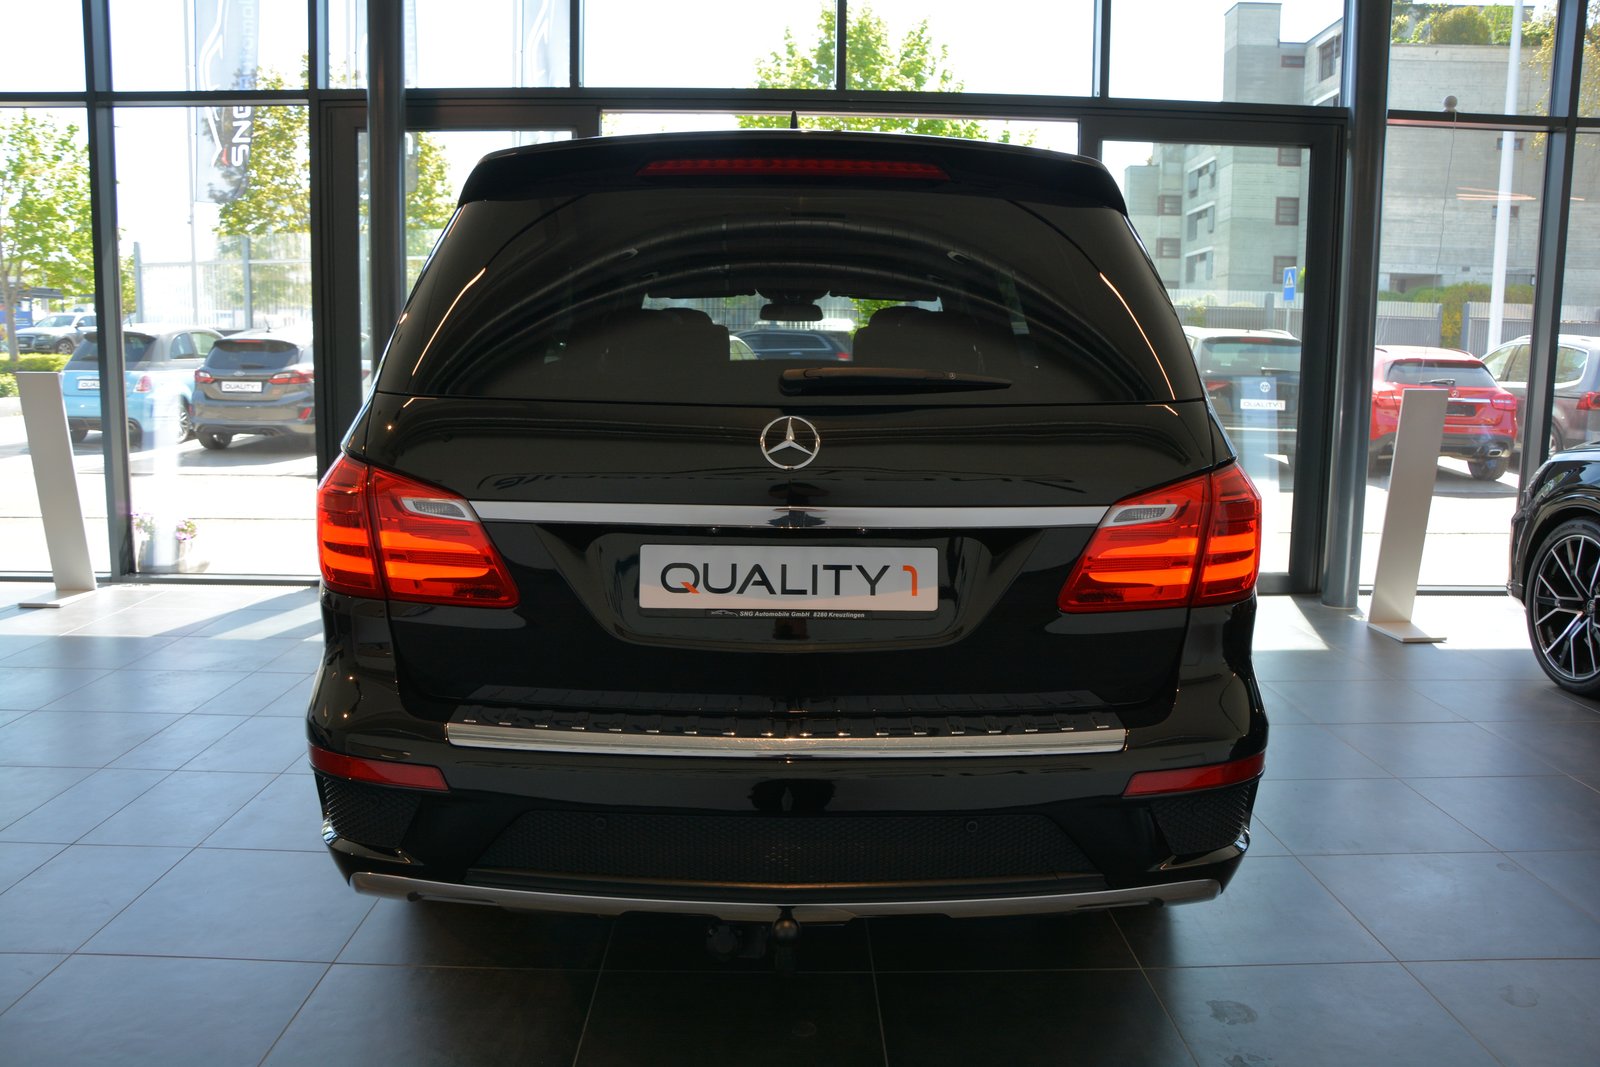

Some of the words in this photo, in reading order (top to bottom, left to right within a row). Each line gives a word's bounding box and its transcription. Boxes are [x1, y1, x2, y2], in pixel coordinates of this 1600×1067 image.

[660, 562, 890, 596] QUALITY
[902, 564, 918, 596] 1
[828, 611, 865, 619] Kreuzlingen
